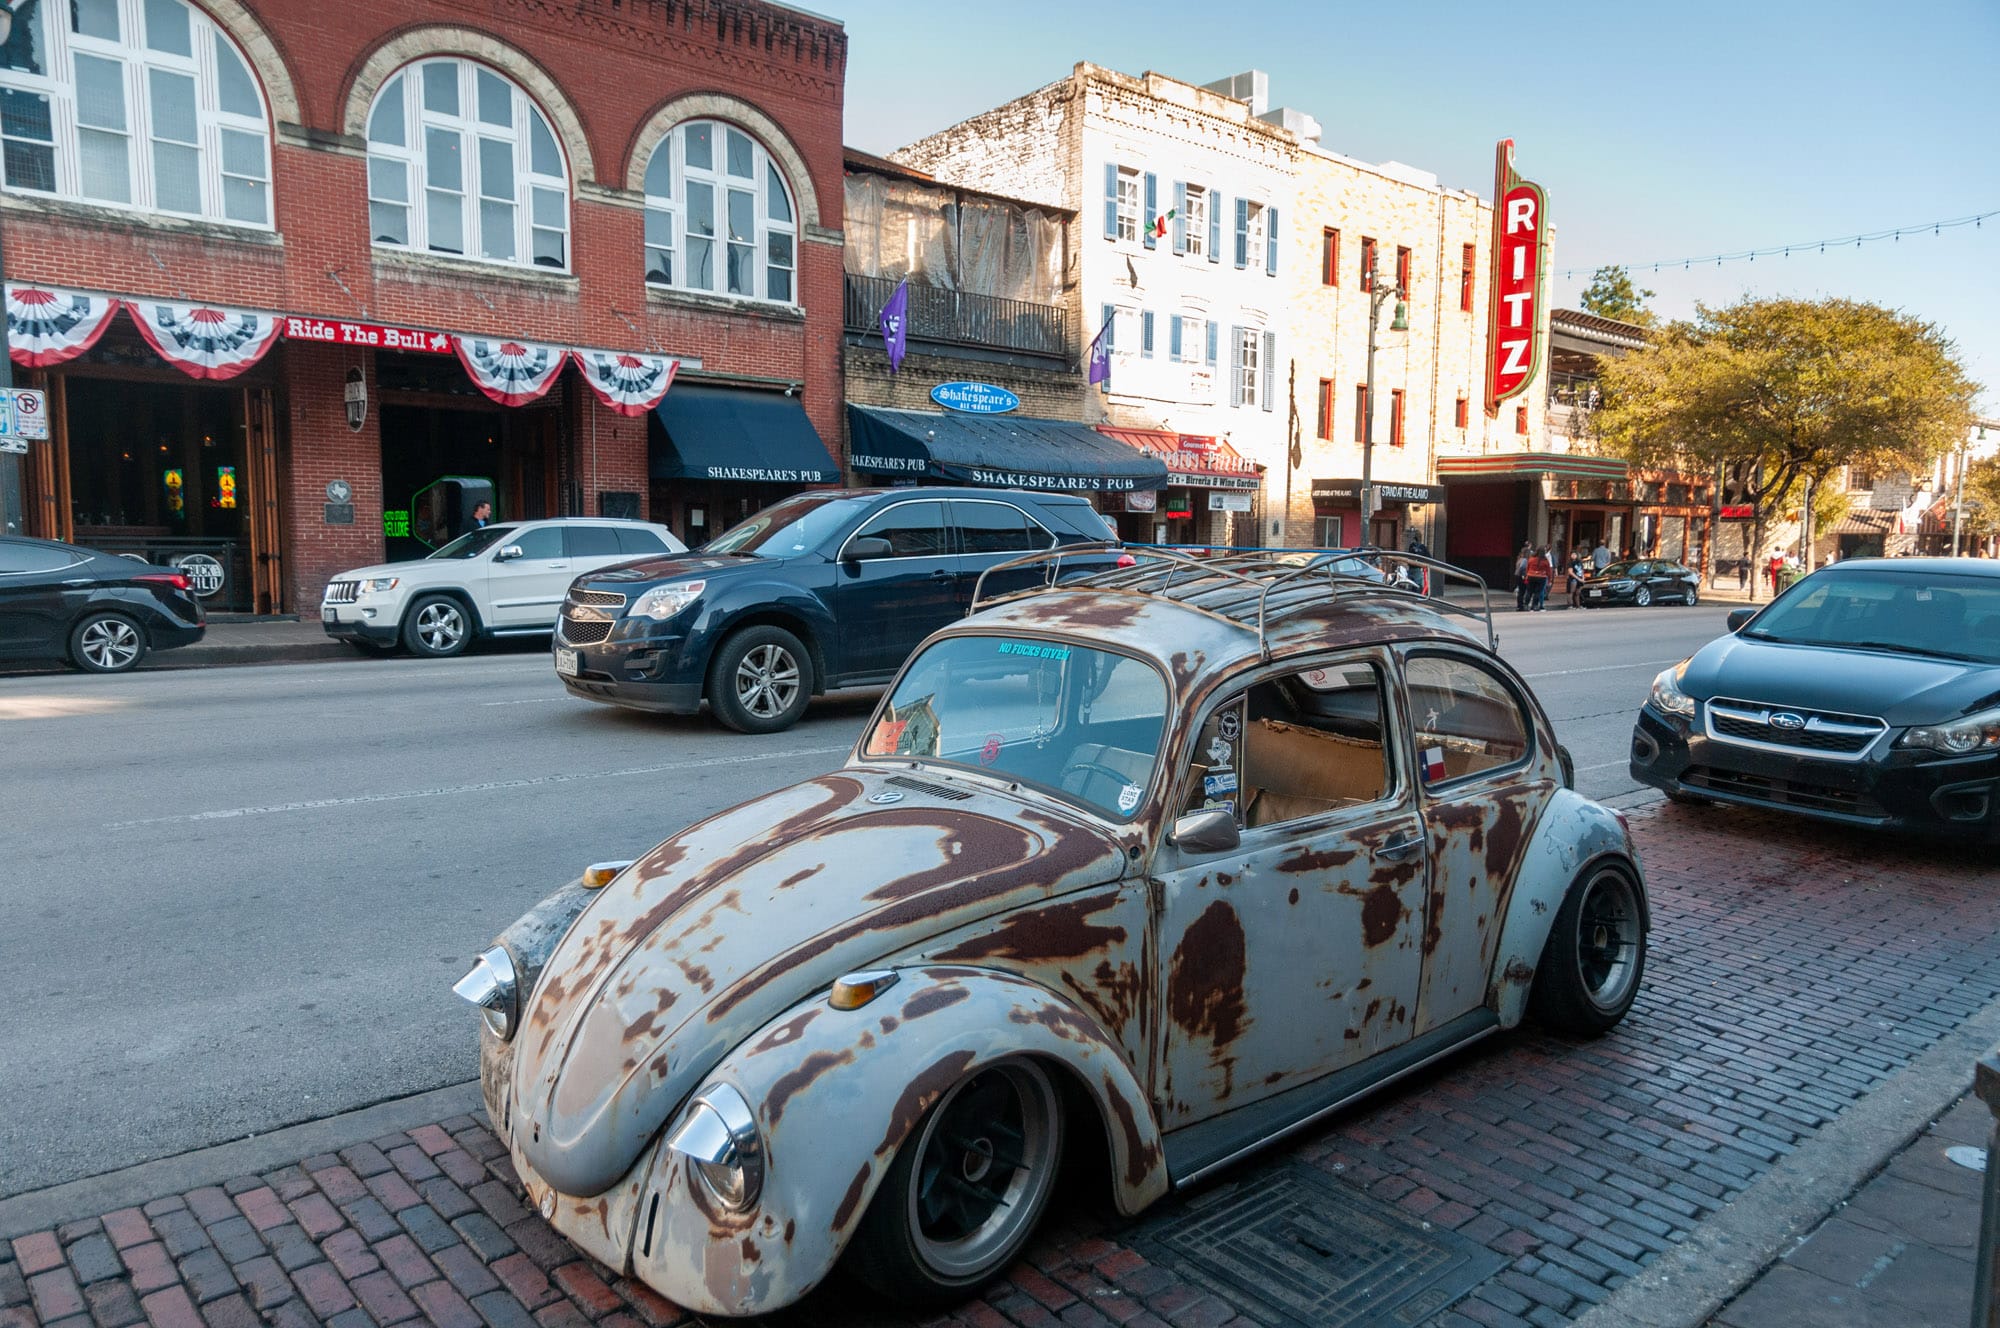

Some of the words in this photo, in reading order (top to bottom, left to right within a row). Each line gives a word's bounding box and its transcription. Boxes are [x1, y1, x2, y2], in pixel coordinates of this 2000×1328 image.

[1501, 198, 1535, 375] RITZ
[288, 318, 335, 340] Ride
[341, 323, 378, 344] The
[384, 328, 426, 349] Bull
[939, 387, 1012, 406] Shakespeare's
[907, 458, 926, 471] PUB
[708, 466, 798, 481] SHAKESPEARE'S
[801, 470, 821, 482] PUB
[973, 470, 1100, 489] SHAKESPEARE'S
[1107, 478, 1134, 490] PUB
[1186, 475, 1211, 486] Birreria
[1219, 478, 1234, 488] Wine
[1236, 478, 1258, 489] Garden
[192, 577, 218, 590] ILD
[998, 643, 1012, 654] NO
[1012, 644, 1040, 657] FUCKS
[1041, 648, 1070, 661] GIVEN
[1121, 795, 1135, 803] STAR
[1123, 790, 1138, 798] LONE
